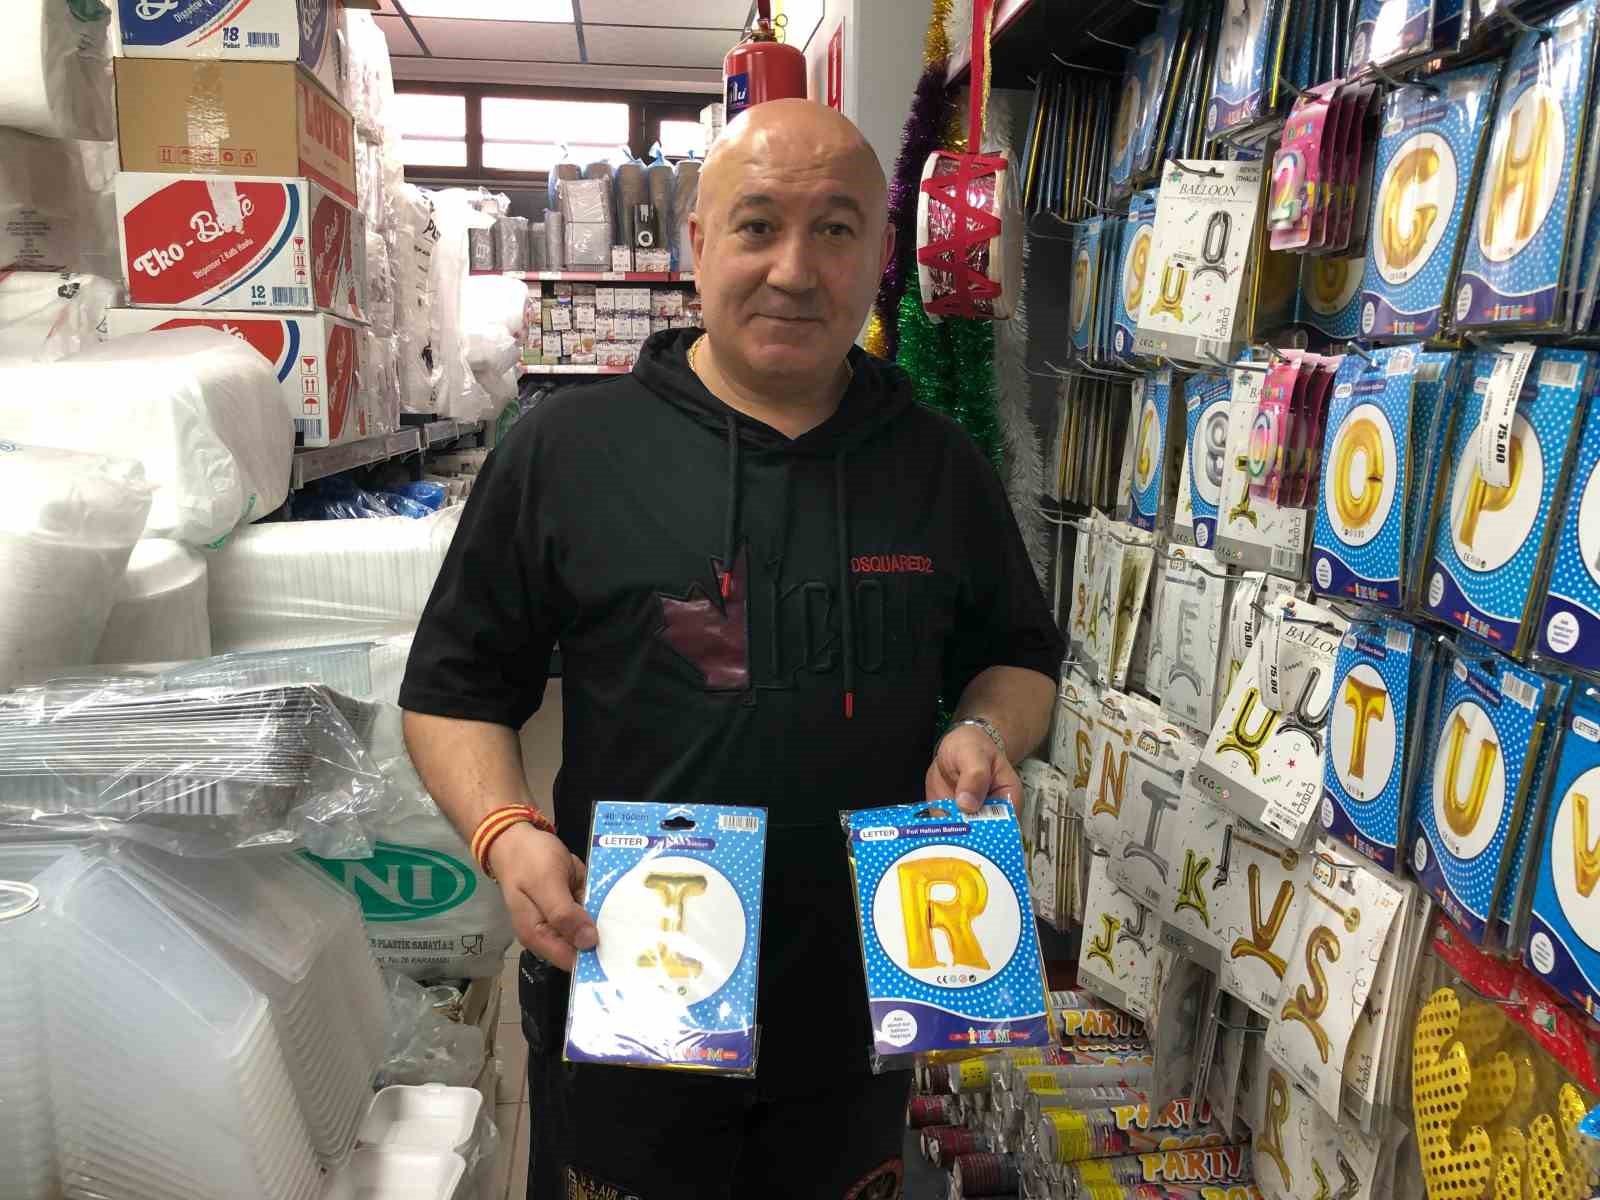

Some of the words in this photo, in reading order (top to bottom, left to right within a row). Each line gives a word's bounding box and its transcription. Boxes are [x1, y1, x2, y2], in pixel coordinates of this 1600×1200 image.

[223, 27, 240, 41] 18
[1484, 96, 1552, 247] H
[1178, 183, 1240, 197] BALLOON
[1381, 147, 1440, 270] G
[133, 243, 185, 278] Eko
[251, 285, 266, 298] 12
[1495, 423, 1509, 464] 75.00
[850, 554, 935, 573] DSQUARED2
[1270, 664, 1279, 694] 75.00
[1345, 675, 1387, 779] T
[1443, 711, 1498, 837] U
[604, 837, 643, 846] LETTER
[862, 829, 897, 839] LETTER
[943, 825, 967, 833] Balloon
[897, 856, 992, 971] R
[1138, 1146, 1242, 1182] PARTY
